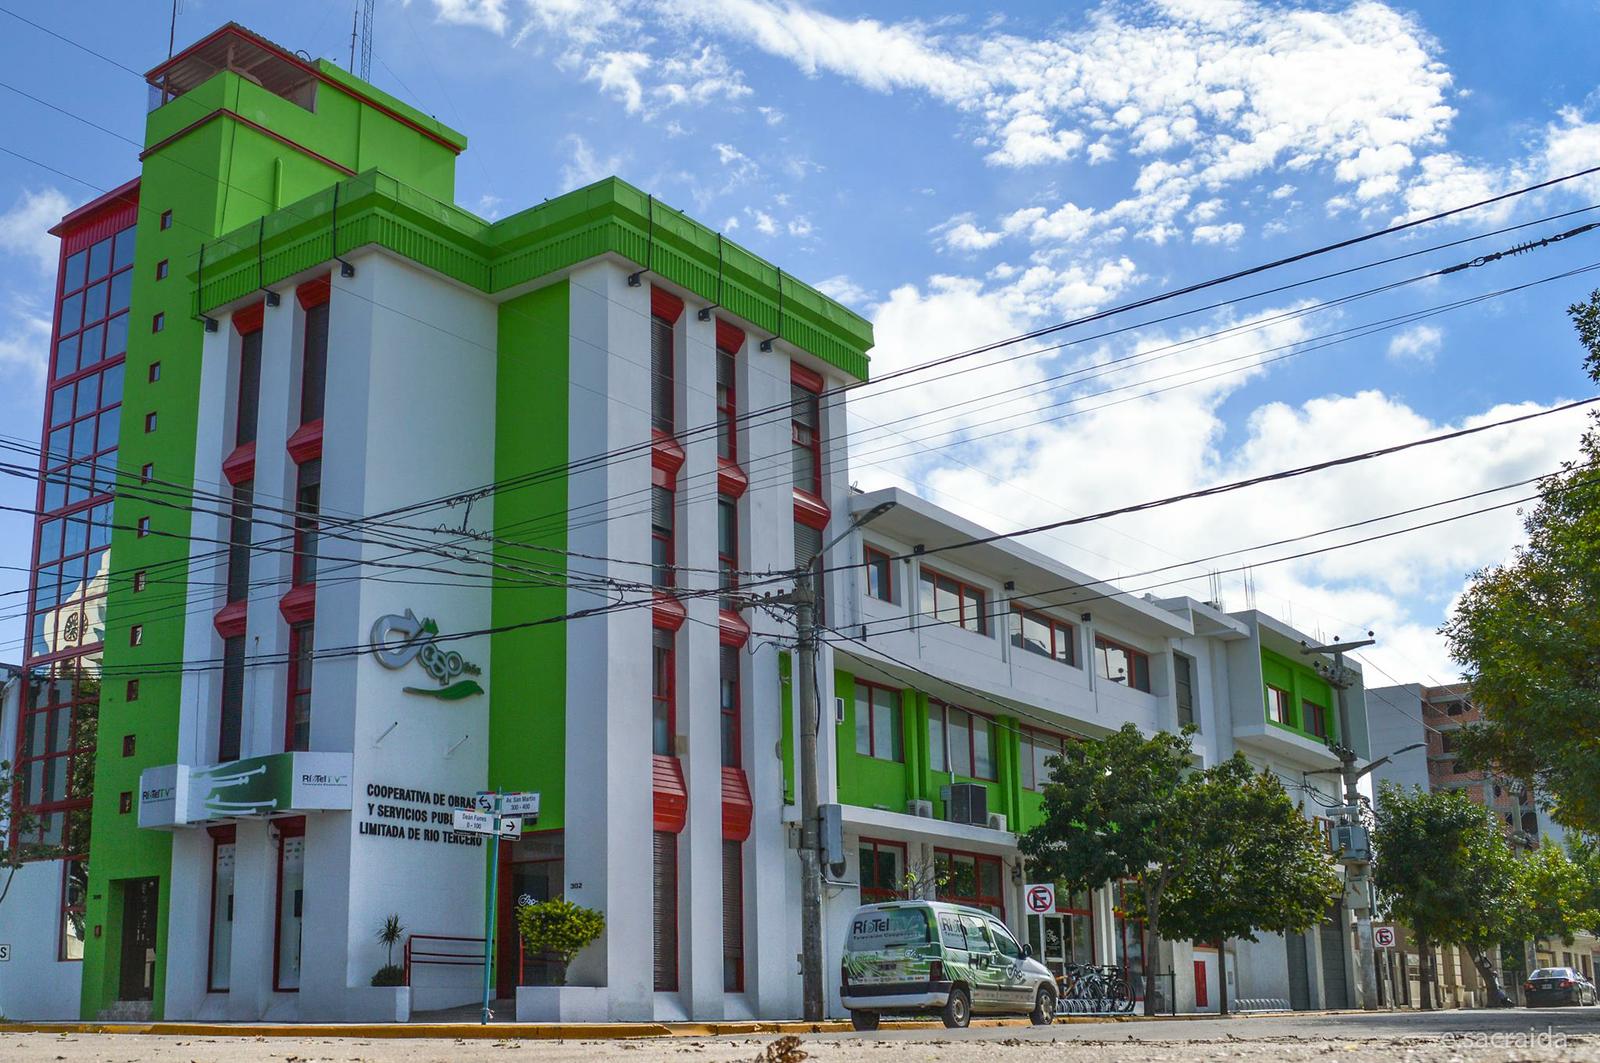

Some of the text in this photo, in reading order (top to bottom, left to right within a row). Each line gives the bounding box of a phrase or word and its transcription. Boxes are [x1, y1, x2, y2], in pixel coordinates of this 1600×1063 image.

[367, 784, 476, 810] COOPERATIVA DE OBRAS
[368, 803, 454, 827] Y SERVICIOS PUBL
[360, 822, 483, 847] LIMITADA DE RIO TERCERO
[1033, 890, 1049, 908] E
